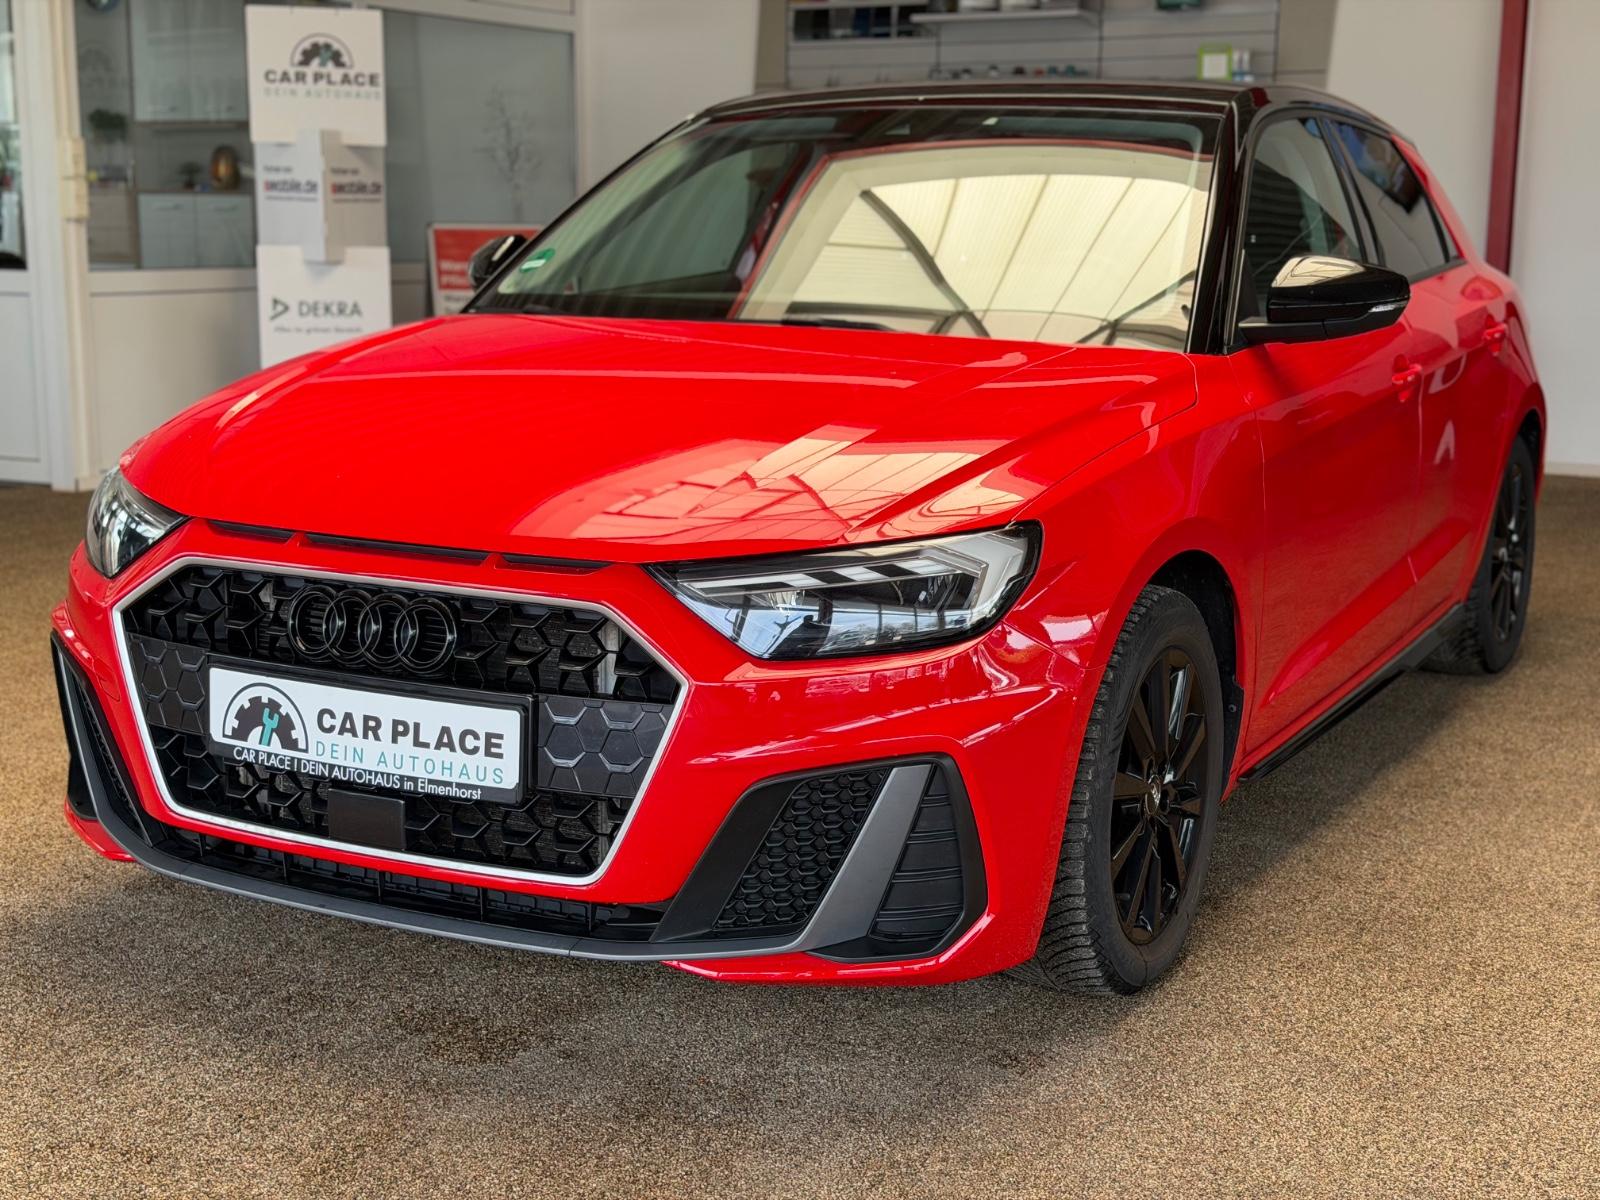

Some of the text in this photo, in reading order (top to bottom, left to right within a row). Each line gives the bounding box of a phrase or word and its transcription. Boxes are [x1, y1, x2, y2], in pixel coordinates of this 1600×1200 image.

[263, 69, 380, 87] CAR PLACE
[298, 300, 363, 318] DEKRA
[316, 708, 505, 760] CAR PLACE
[233, 746, 256, 763] CAR
[258, 751, 291, 770] PLACE
[301, 760, 329, 777] DEIN
[331, 765, 401, 789] AUTOHAUS
[403, 778, 414, 791] in
[417, 778, 482, 800] Elmenhorst
[315, 740, 504, 785] DEIN AUTOHAUS
